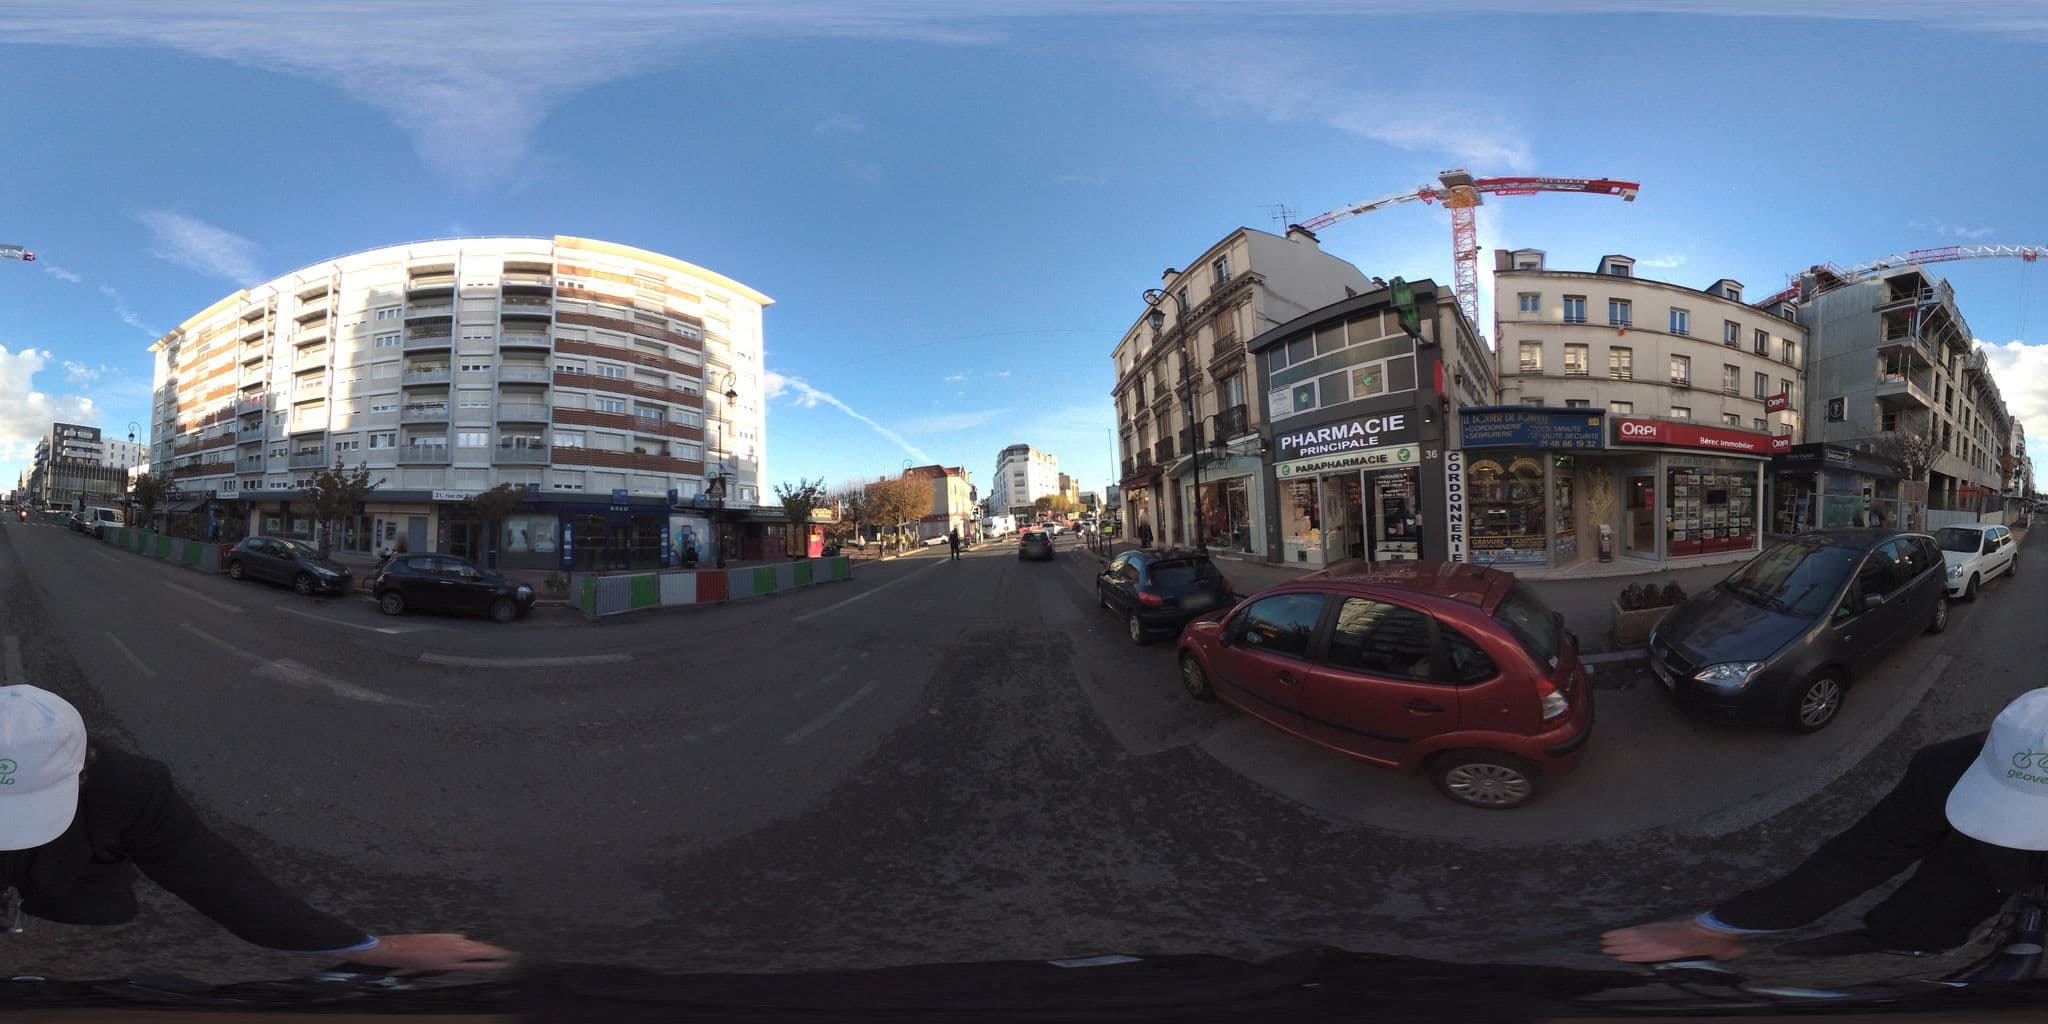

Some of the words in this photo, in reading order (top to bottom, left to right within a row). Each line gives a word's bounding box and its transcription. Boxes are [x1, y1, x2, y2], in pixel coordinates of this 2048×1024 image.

[1767, 398, 1785, 408] ORPI
[1281, 415, 1405, 450] PHARMACIE
[1621, 422, 1657, 436] ORPI
[1300, 436, 1379, 457] PRINCIPALE
[1700, 437, 1720, 447] Bérec
[1720, 439, 1754, 450] Immobilier
[1772, 439, 1788, 448] ORPI
[1426, 450, 1437, 459] 36
[1295, 454, 1388, 473] PARAPHARMACIE
[1448, 453, 1463, 562] CORDONNERIE
